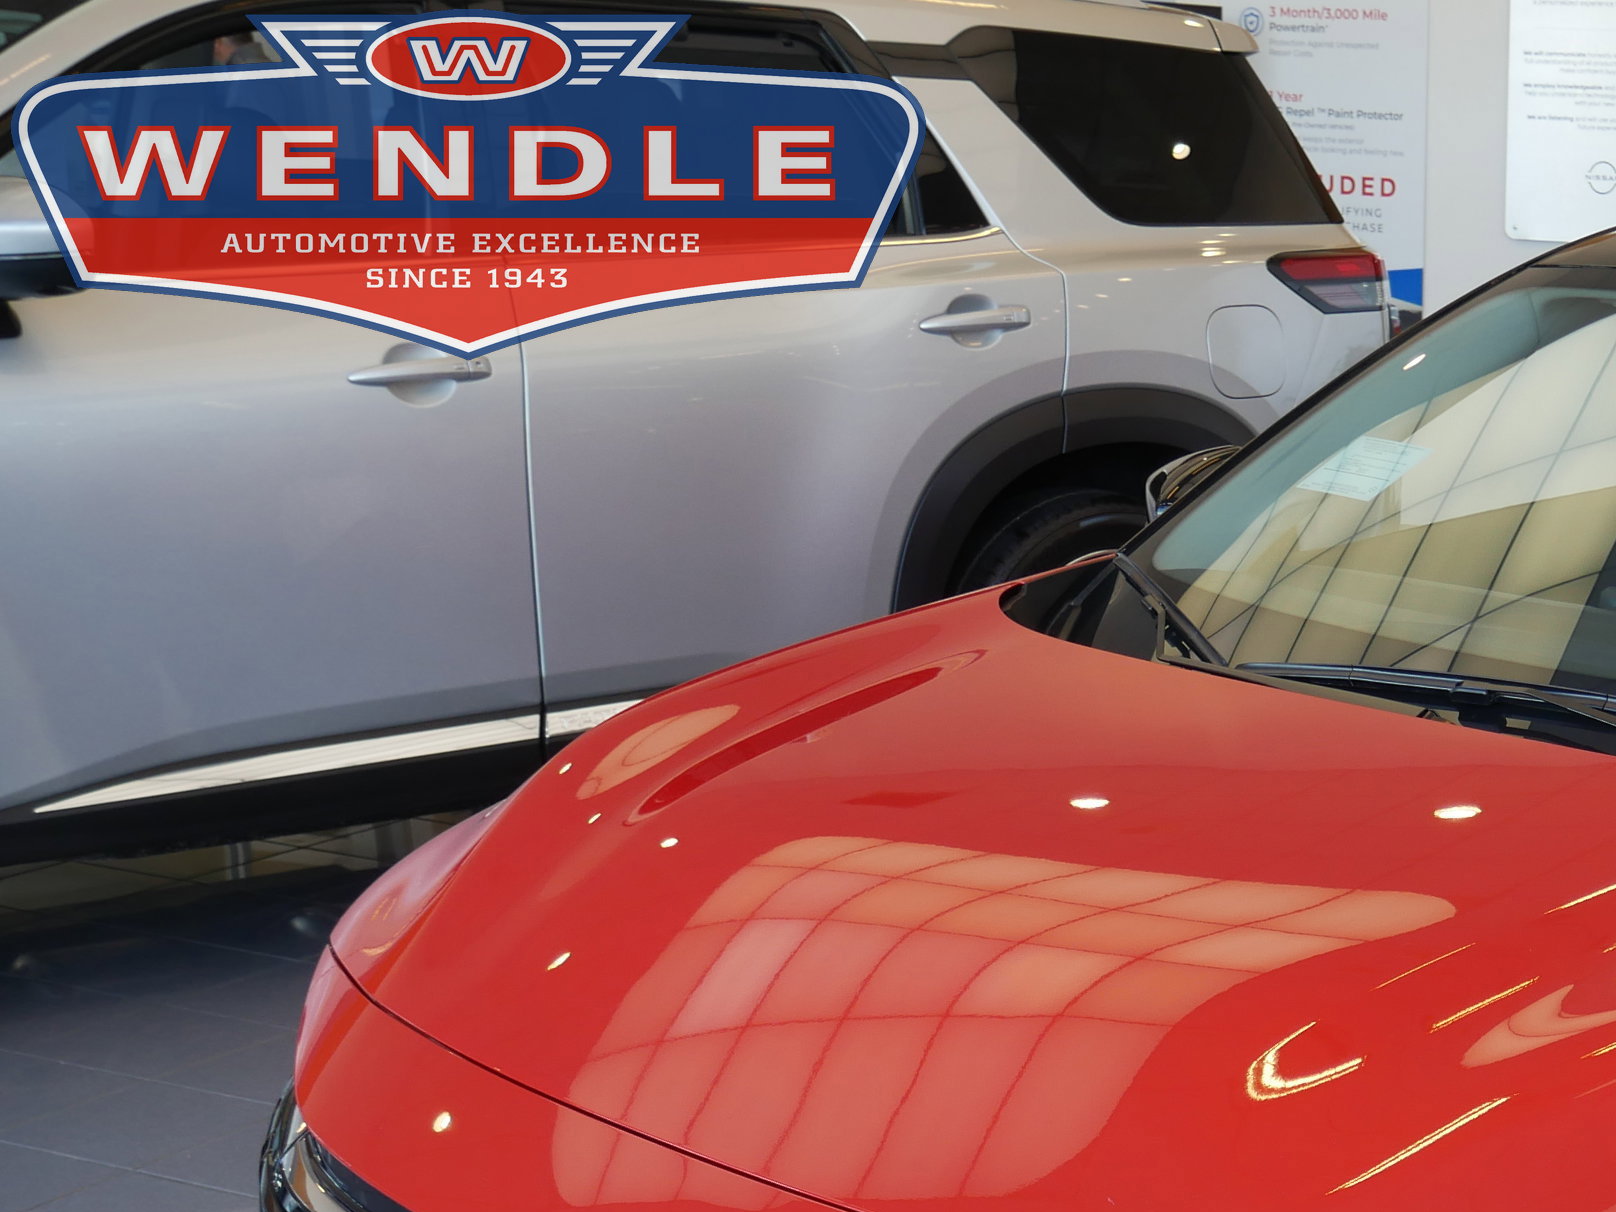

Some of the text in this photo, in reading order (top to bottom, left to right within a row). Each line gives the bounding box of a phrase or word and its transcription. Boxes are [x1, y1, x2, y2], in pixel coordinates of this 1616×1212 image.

[1269, 6, 1389, 21] 3 Month/3,000 Mile
[1277, 91, 1303, 102] Year
[1286, 105, 1315, 118] Repel
[1328, 107, 1354, 119] Paint
[1356, 109, 1404, 121] Protector
[1347, 221, 1384, 233] HASE
